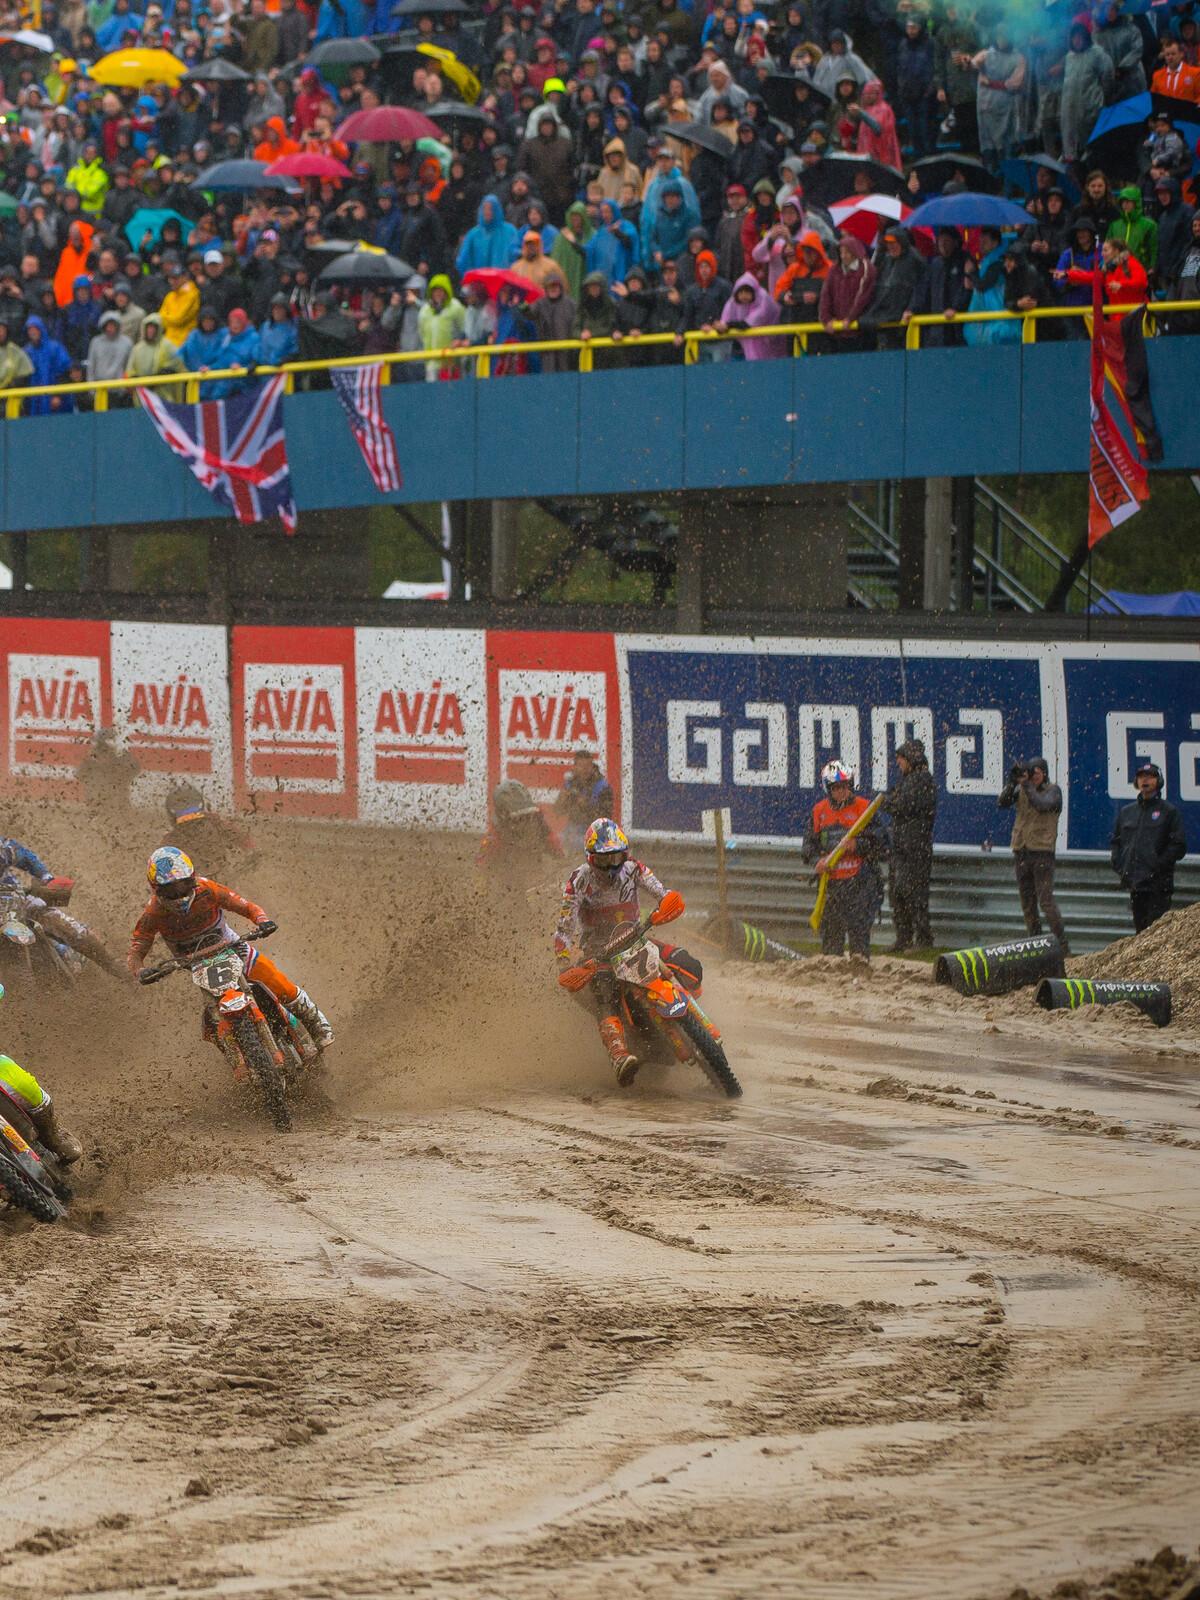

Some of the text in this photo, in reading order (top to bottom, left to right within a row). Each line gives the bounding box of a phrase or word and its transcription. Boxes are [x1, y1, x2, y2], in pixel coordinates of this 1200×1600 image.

[985, 938, 1051, 958] MONSTER
[999, 949, 1044, 963] ENERGY
[624, 947, 649, 979] 7
[206, 960, 234, 990] 6
[1095, 983, 1161, 992] MONSTER
